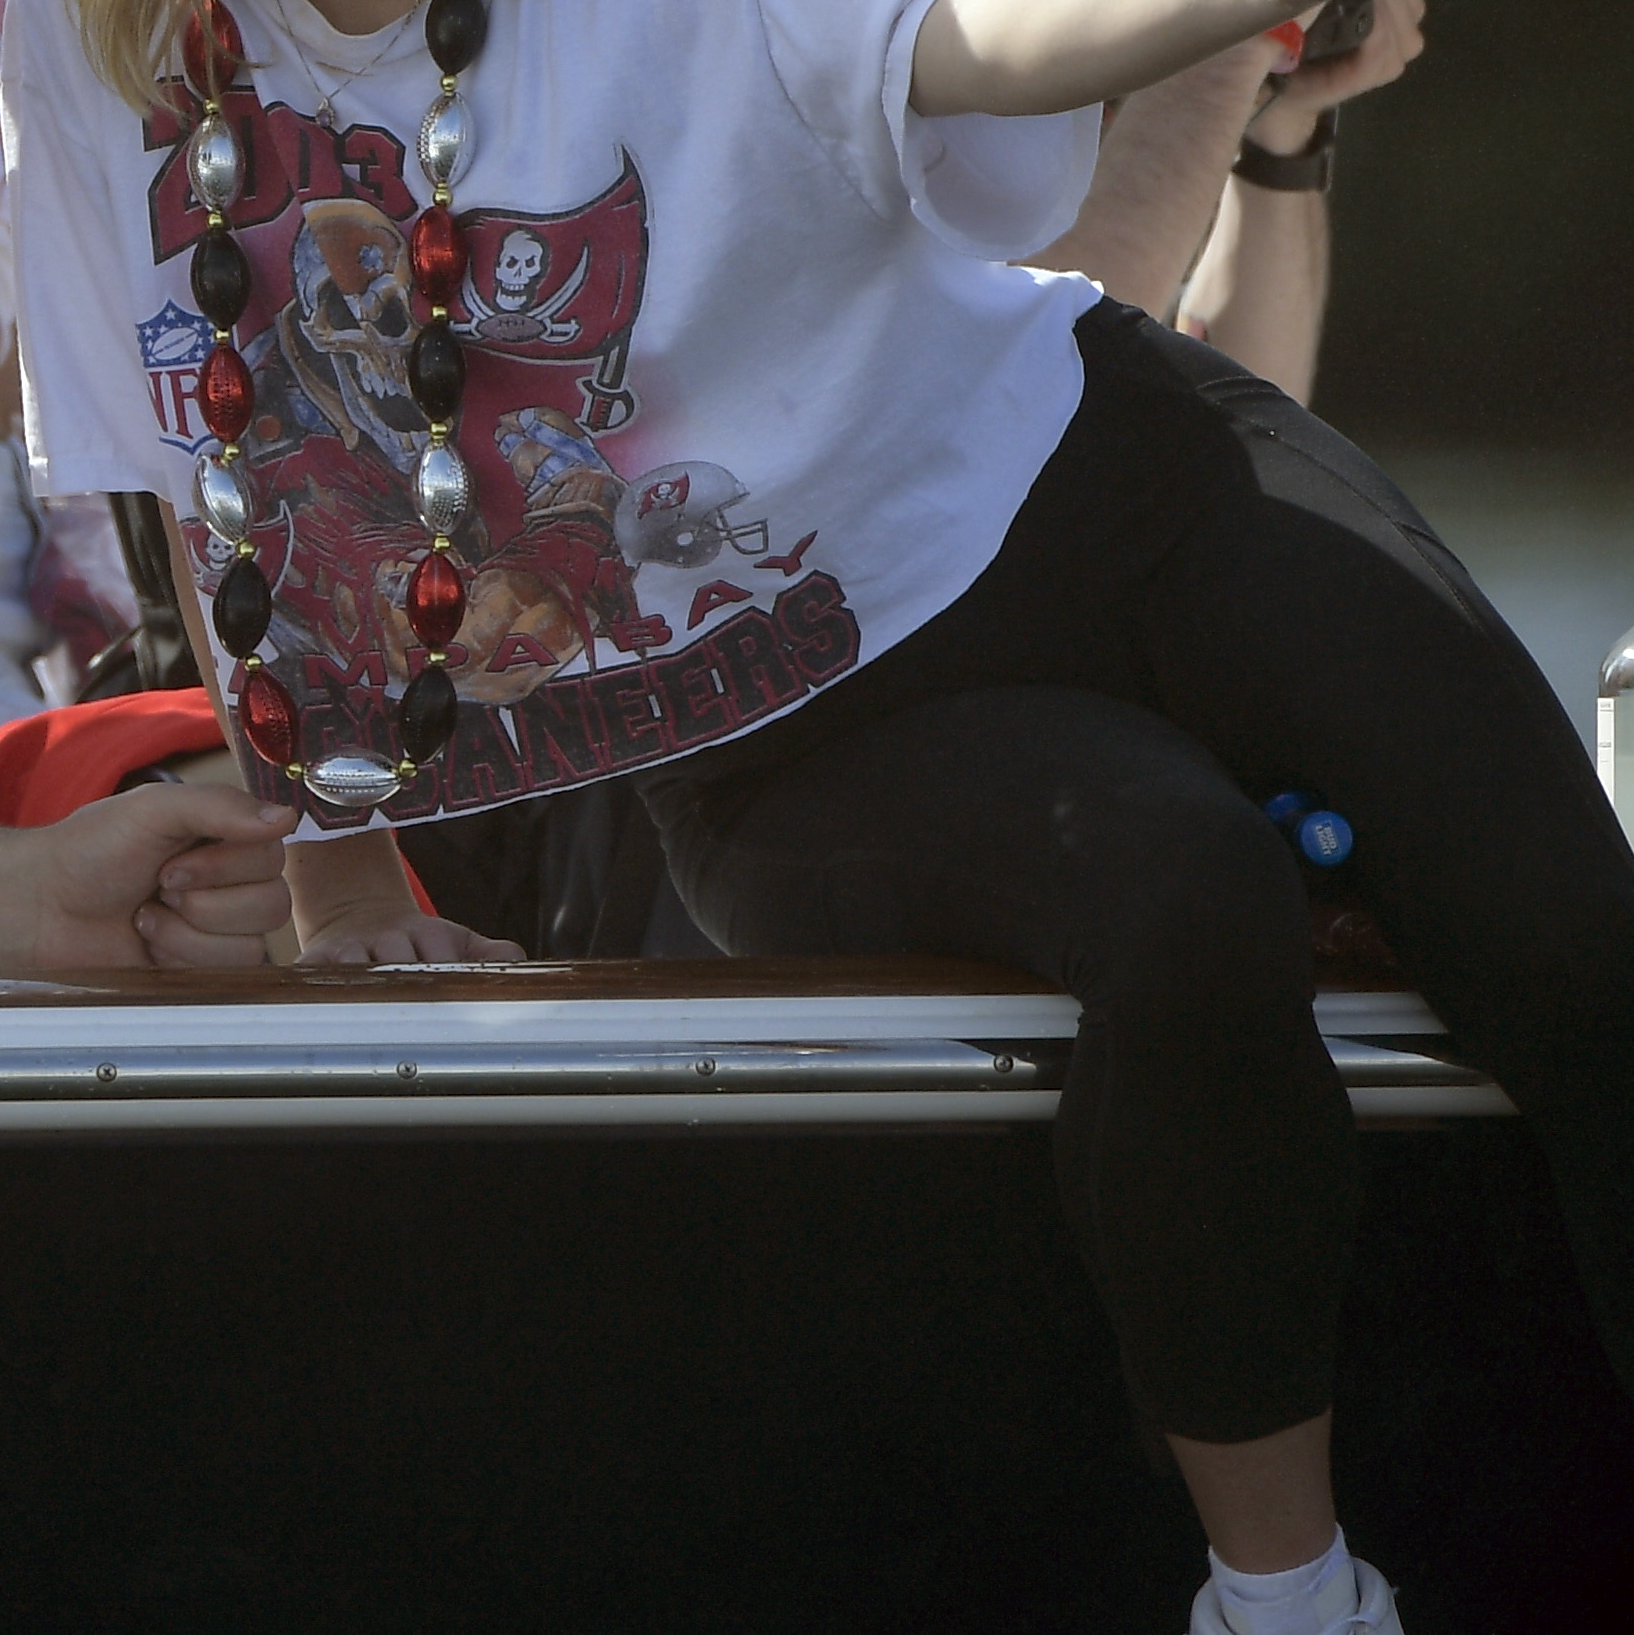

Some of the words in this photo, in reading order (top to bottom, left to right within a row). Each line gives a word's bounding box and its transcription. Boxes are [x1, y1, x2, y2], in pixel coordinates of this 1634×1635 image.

[145, 368, 201, 439] NF
[608, 530, 819, 653] BAY
[1315, 825, 1332, 855] LIGHT
[1322, 826, 1337, 849] BUD
